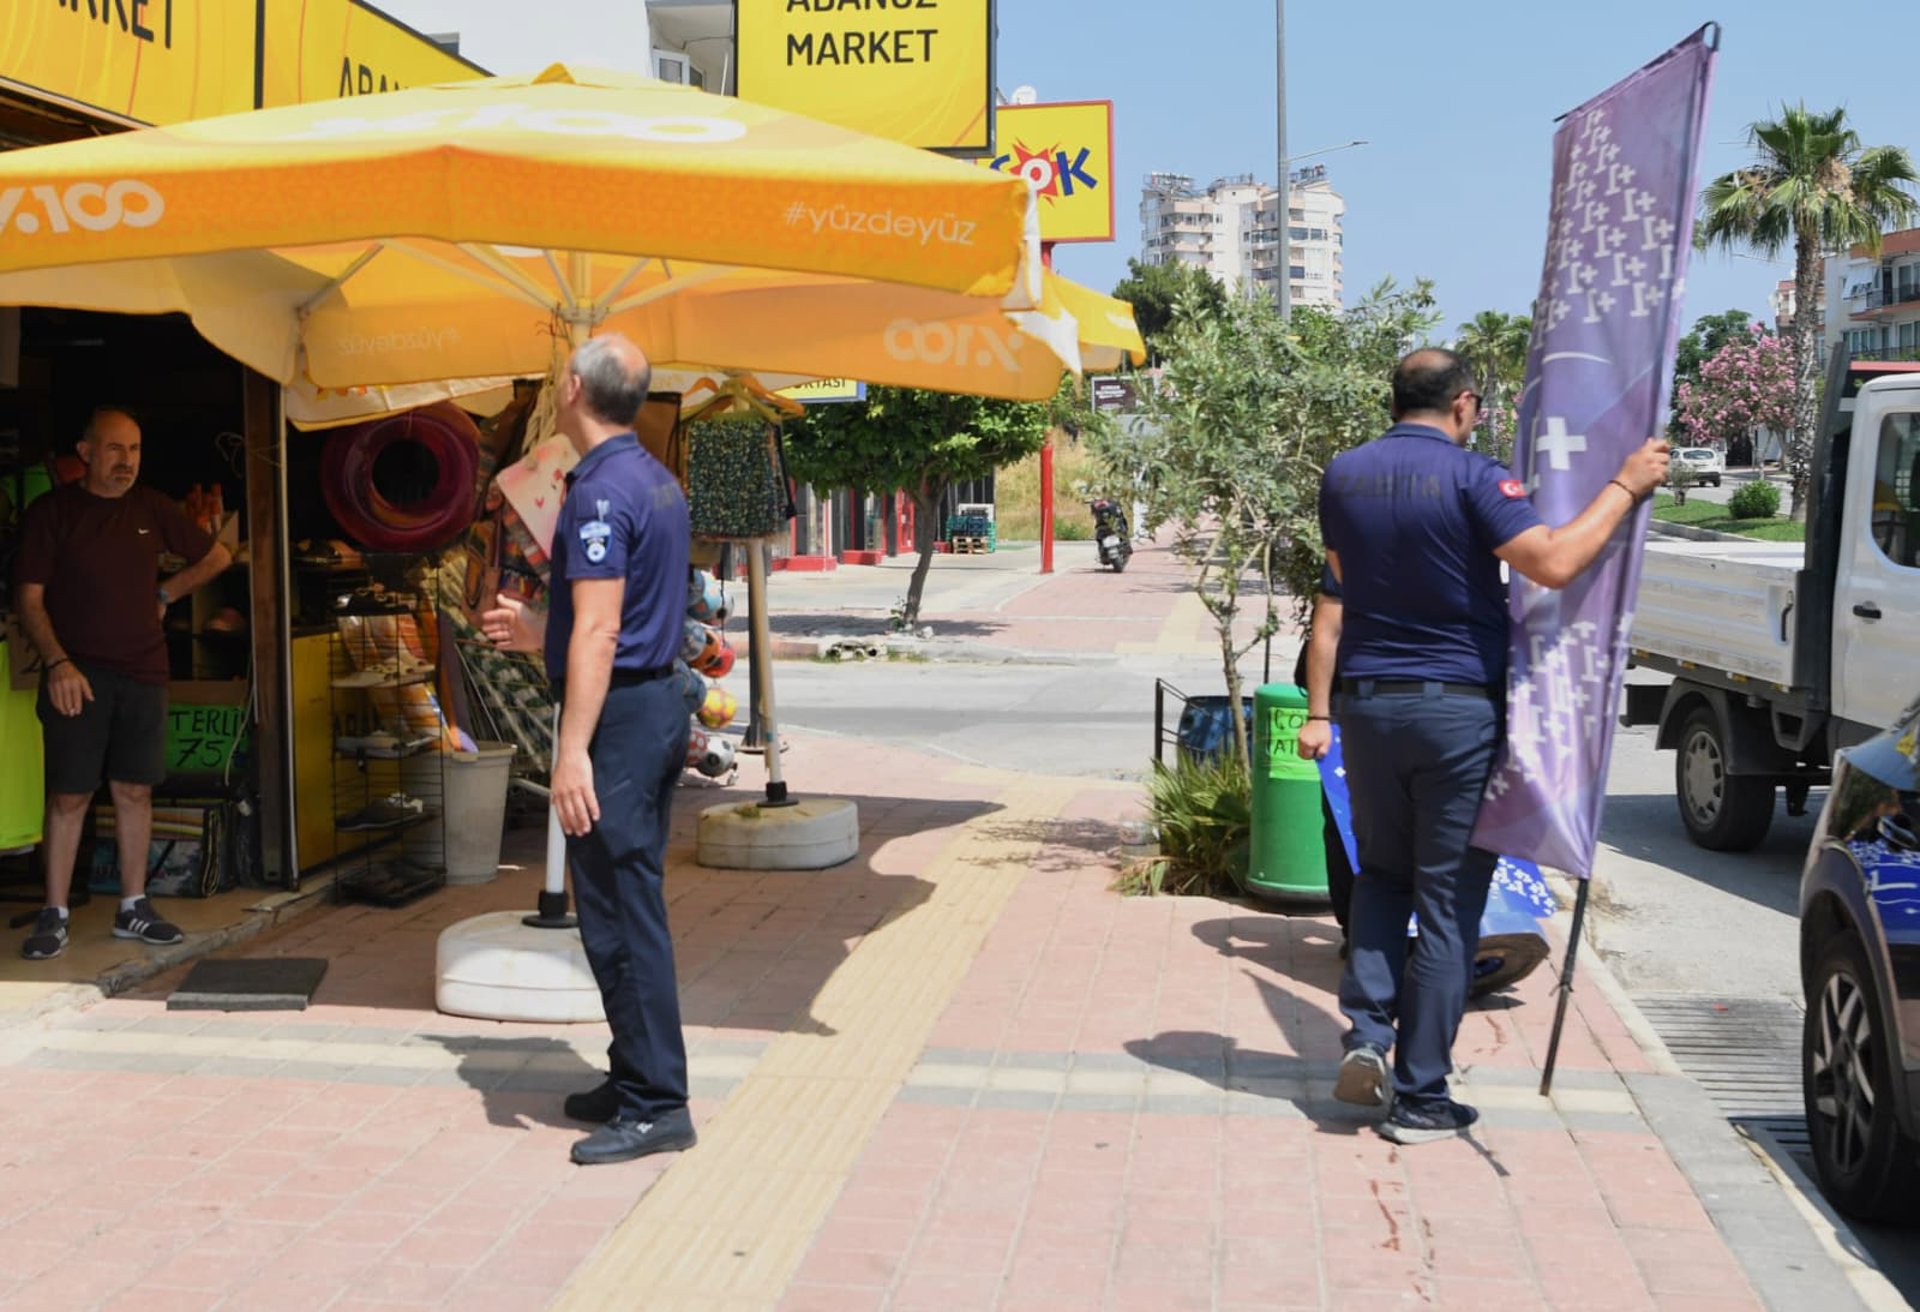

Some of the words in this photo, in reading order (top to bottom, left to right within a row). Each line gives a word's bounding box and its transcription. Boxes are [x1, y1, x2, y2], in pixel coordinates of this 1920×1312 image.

[786, 29, 939, 66] MARKET
[784, 201, 977, 246] #yüzdeyüz
[176, 738, 225, 768] 75
